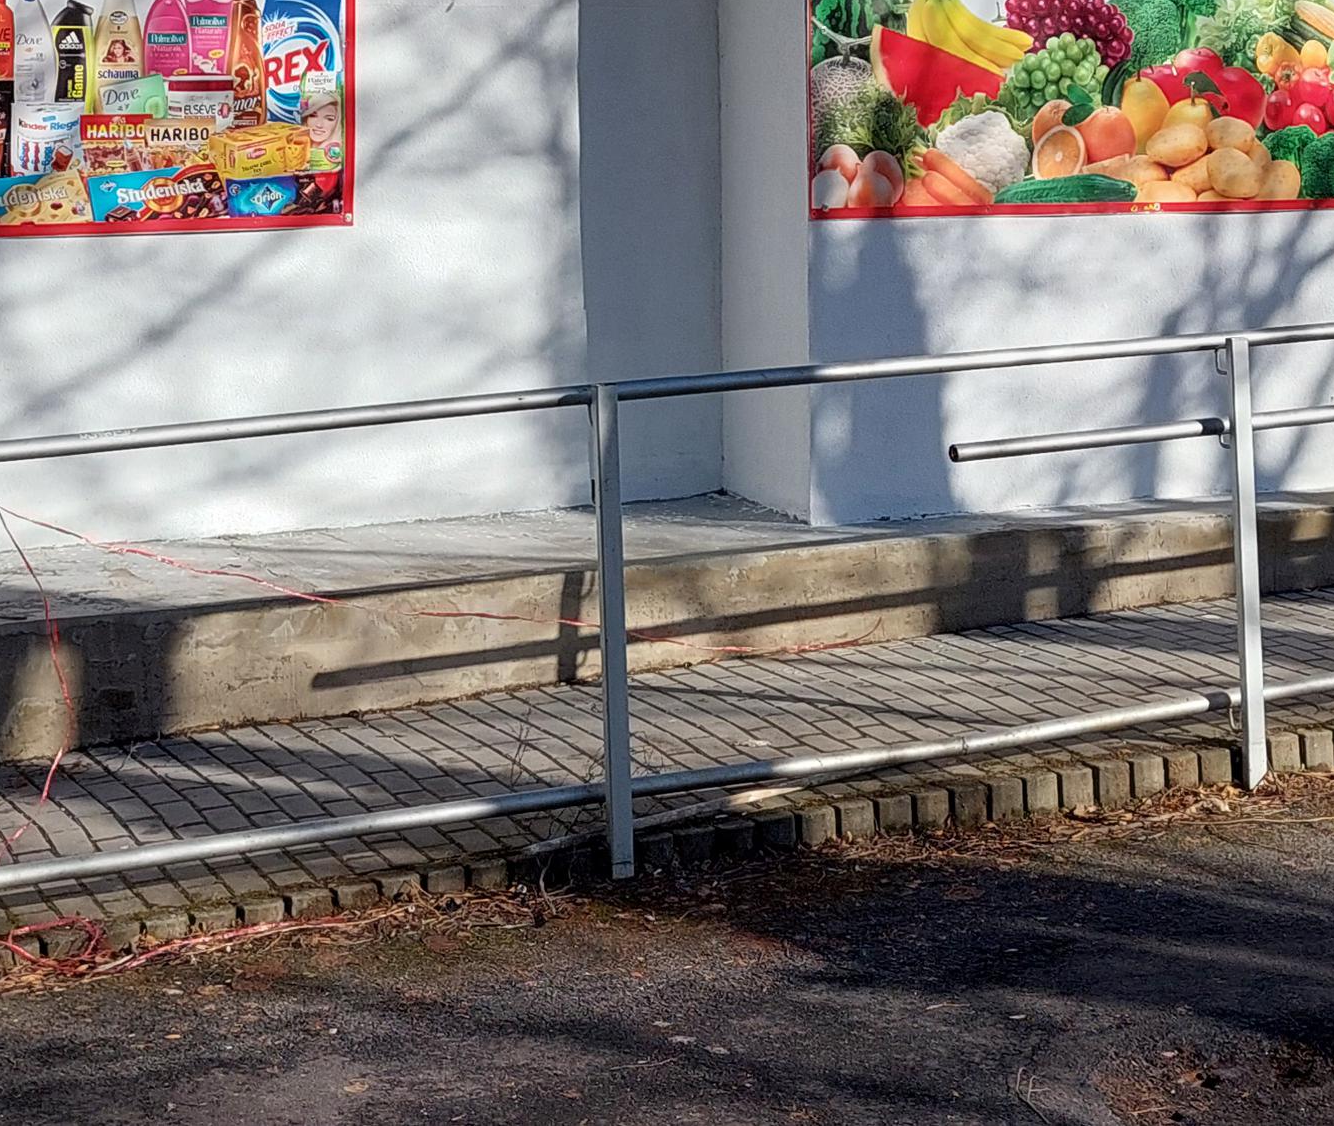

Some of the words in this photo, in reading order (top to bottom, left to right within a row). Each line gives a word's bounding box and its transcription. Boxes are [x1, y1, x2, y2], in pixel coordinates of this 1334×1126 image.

[192, 16, 226, 26] Palmolive
[16, 34, 42, 45] Dove
[151, 34, 184, 43] Palmolive
[98, 69, 138, 79] schauma
[72, 65, 84, 98] Game
[104, 89, 139, 106] Dove
[87, 124, 144, 138] HARIBO
[150, 127, 210, 141] HARIBO
[117, 178, 206, 204] Studentská
[255, 189, 281, 203] Orion
